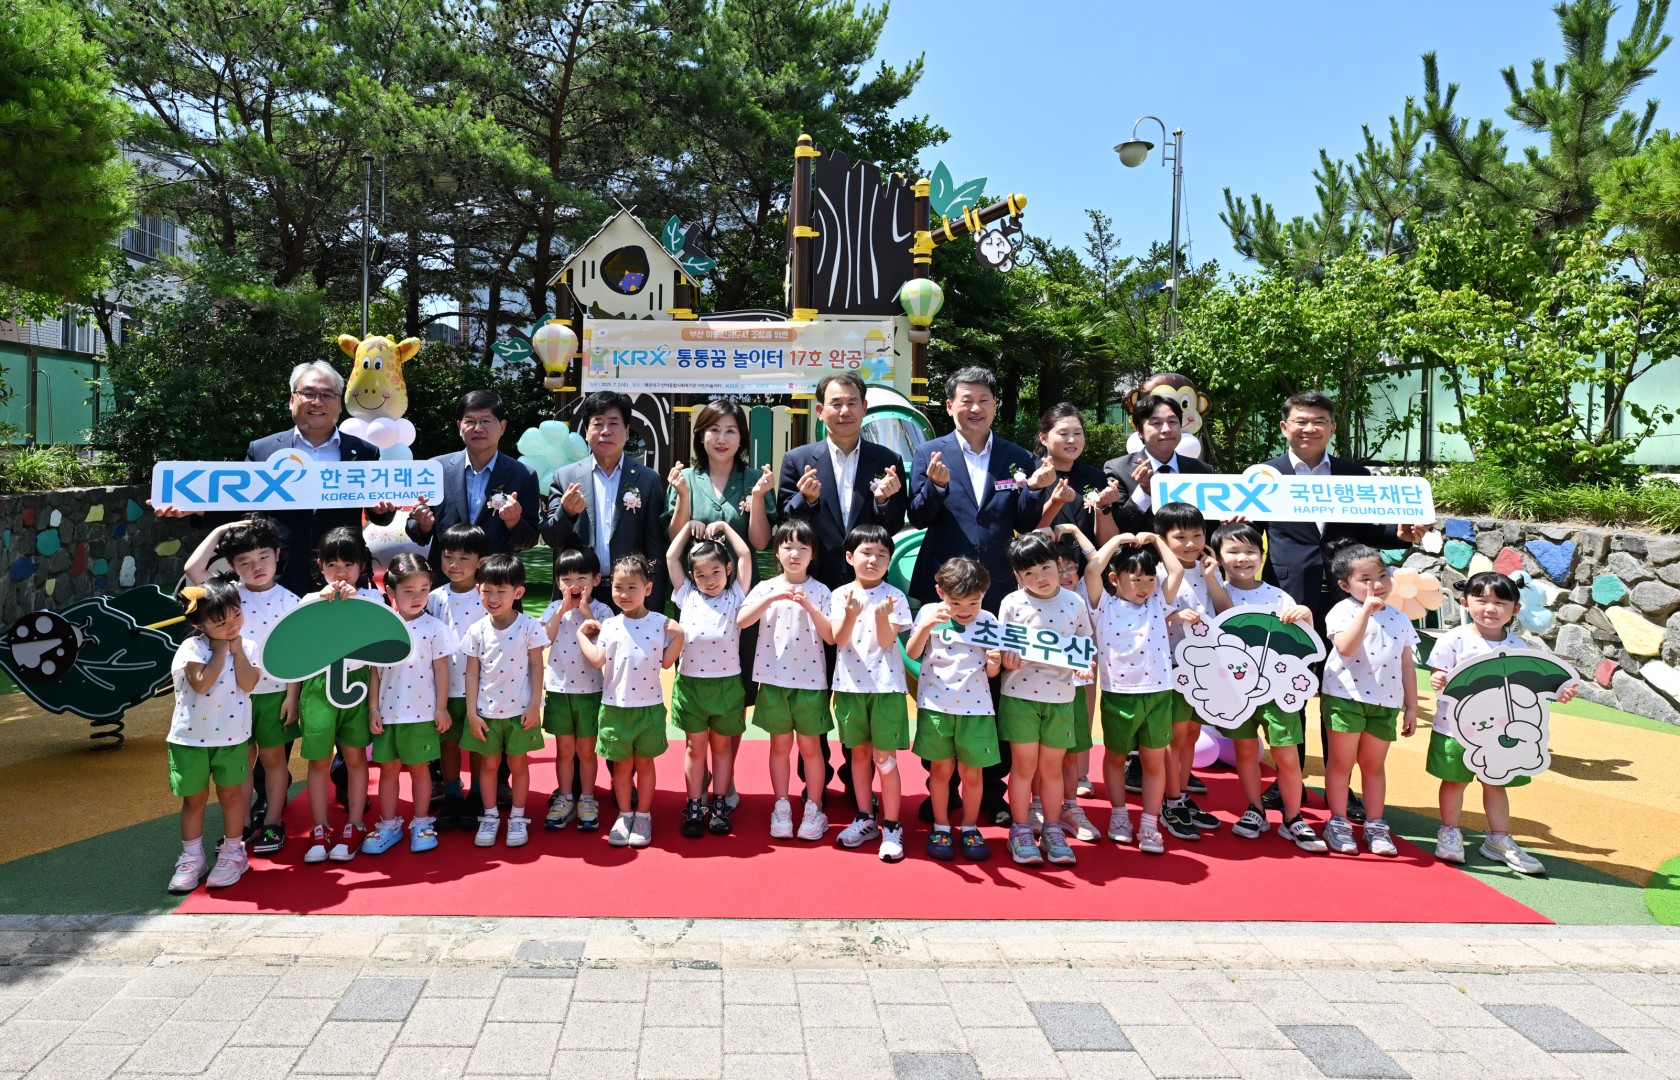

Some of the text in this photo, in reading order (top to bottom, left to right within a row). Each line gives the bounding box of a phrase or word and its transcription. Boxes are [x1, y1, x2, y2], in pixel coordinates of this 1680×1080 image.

[689, 330, 704, 339] 부산
[774, 330, 789, 339] 위한
[612, 348, 863, 369] KRX 통통꿈 놀이터 17호 완공
[161, 469, 300, 503] KRX
[320, 467, 436, 489] 한국거래소
[321, 490, 436, 501] KOREA EXCHANGE
[1159, 482, 1274, 513] KRX
[1289, 483, 1423, 505] 국민행복재단
[1293, 505, 1424, 516] HAPPY FOUNDATION
[971, 620, 1095, 669] 초록우산
